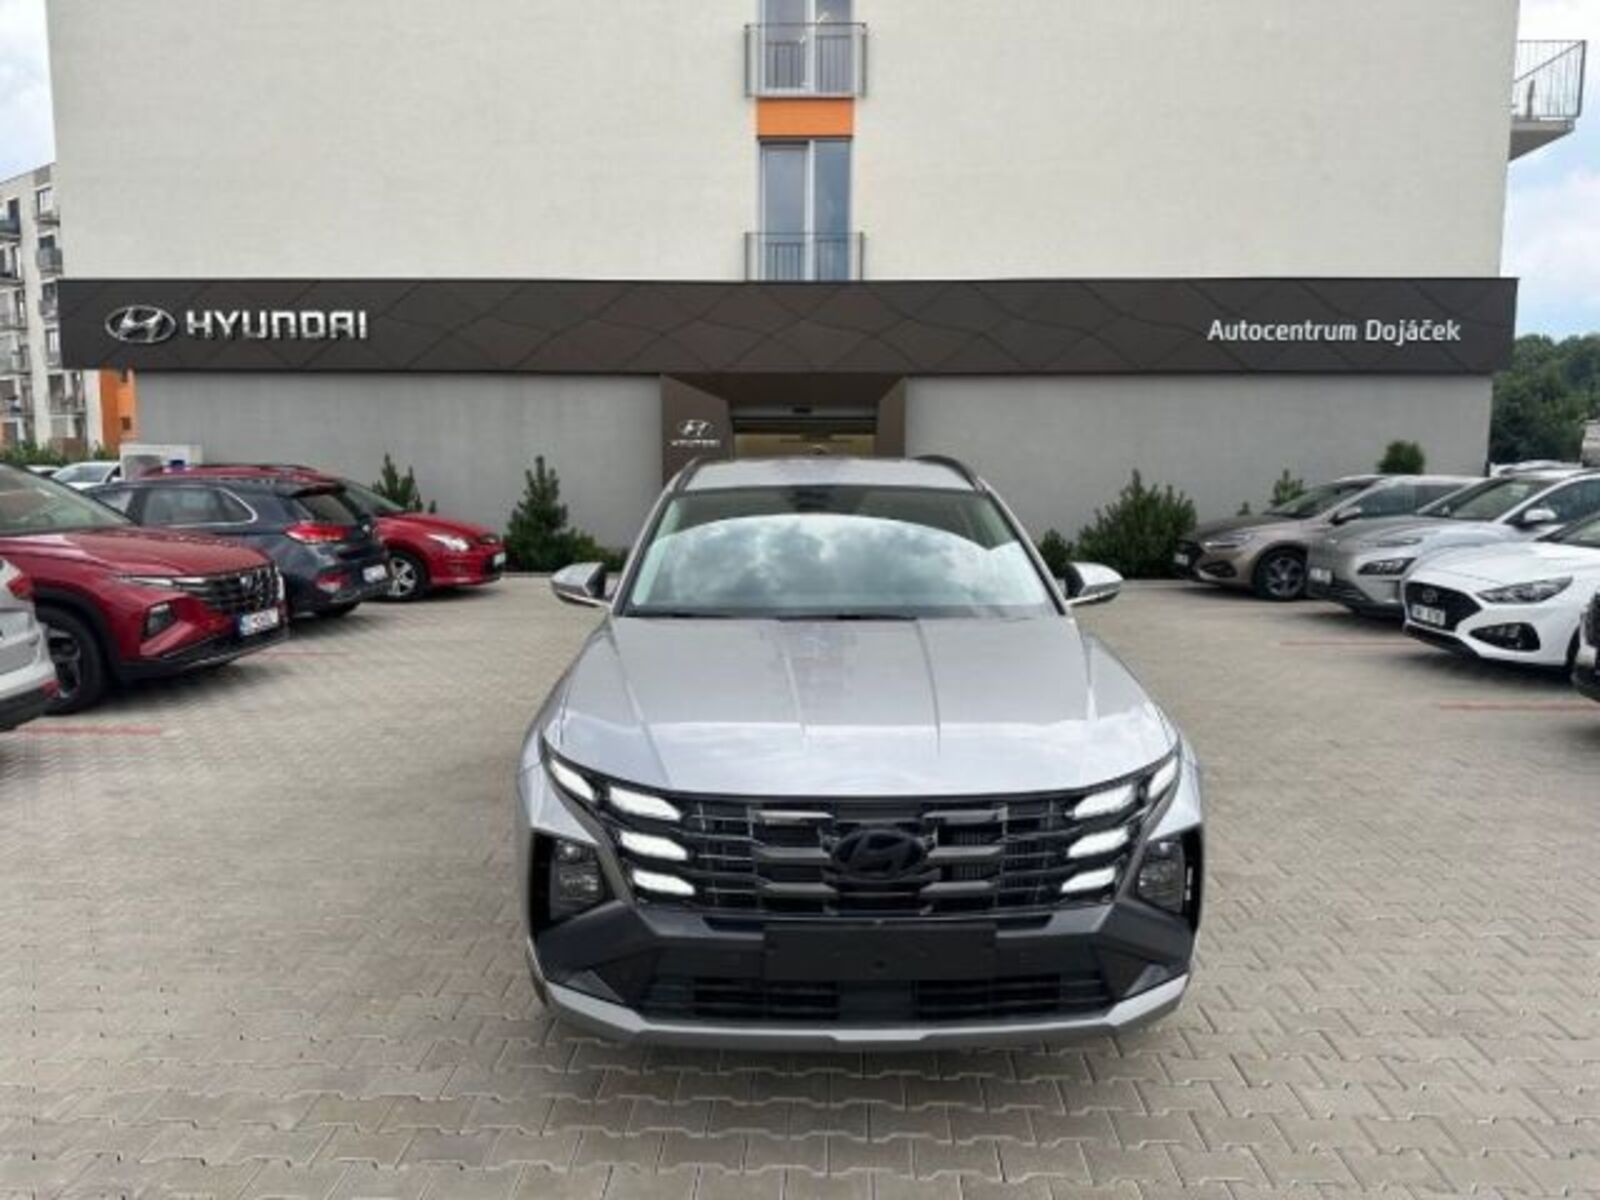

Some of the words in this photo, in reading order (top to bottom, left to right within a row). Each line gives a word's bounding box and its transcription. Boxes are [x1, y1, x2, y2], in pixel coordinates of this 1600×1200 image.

[185, 310, 368, 339] HYUNDAI
[1207, 318, 1358, 342] Autocentrum
[1364, 318, 1462, 347] Dojáček
